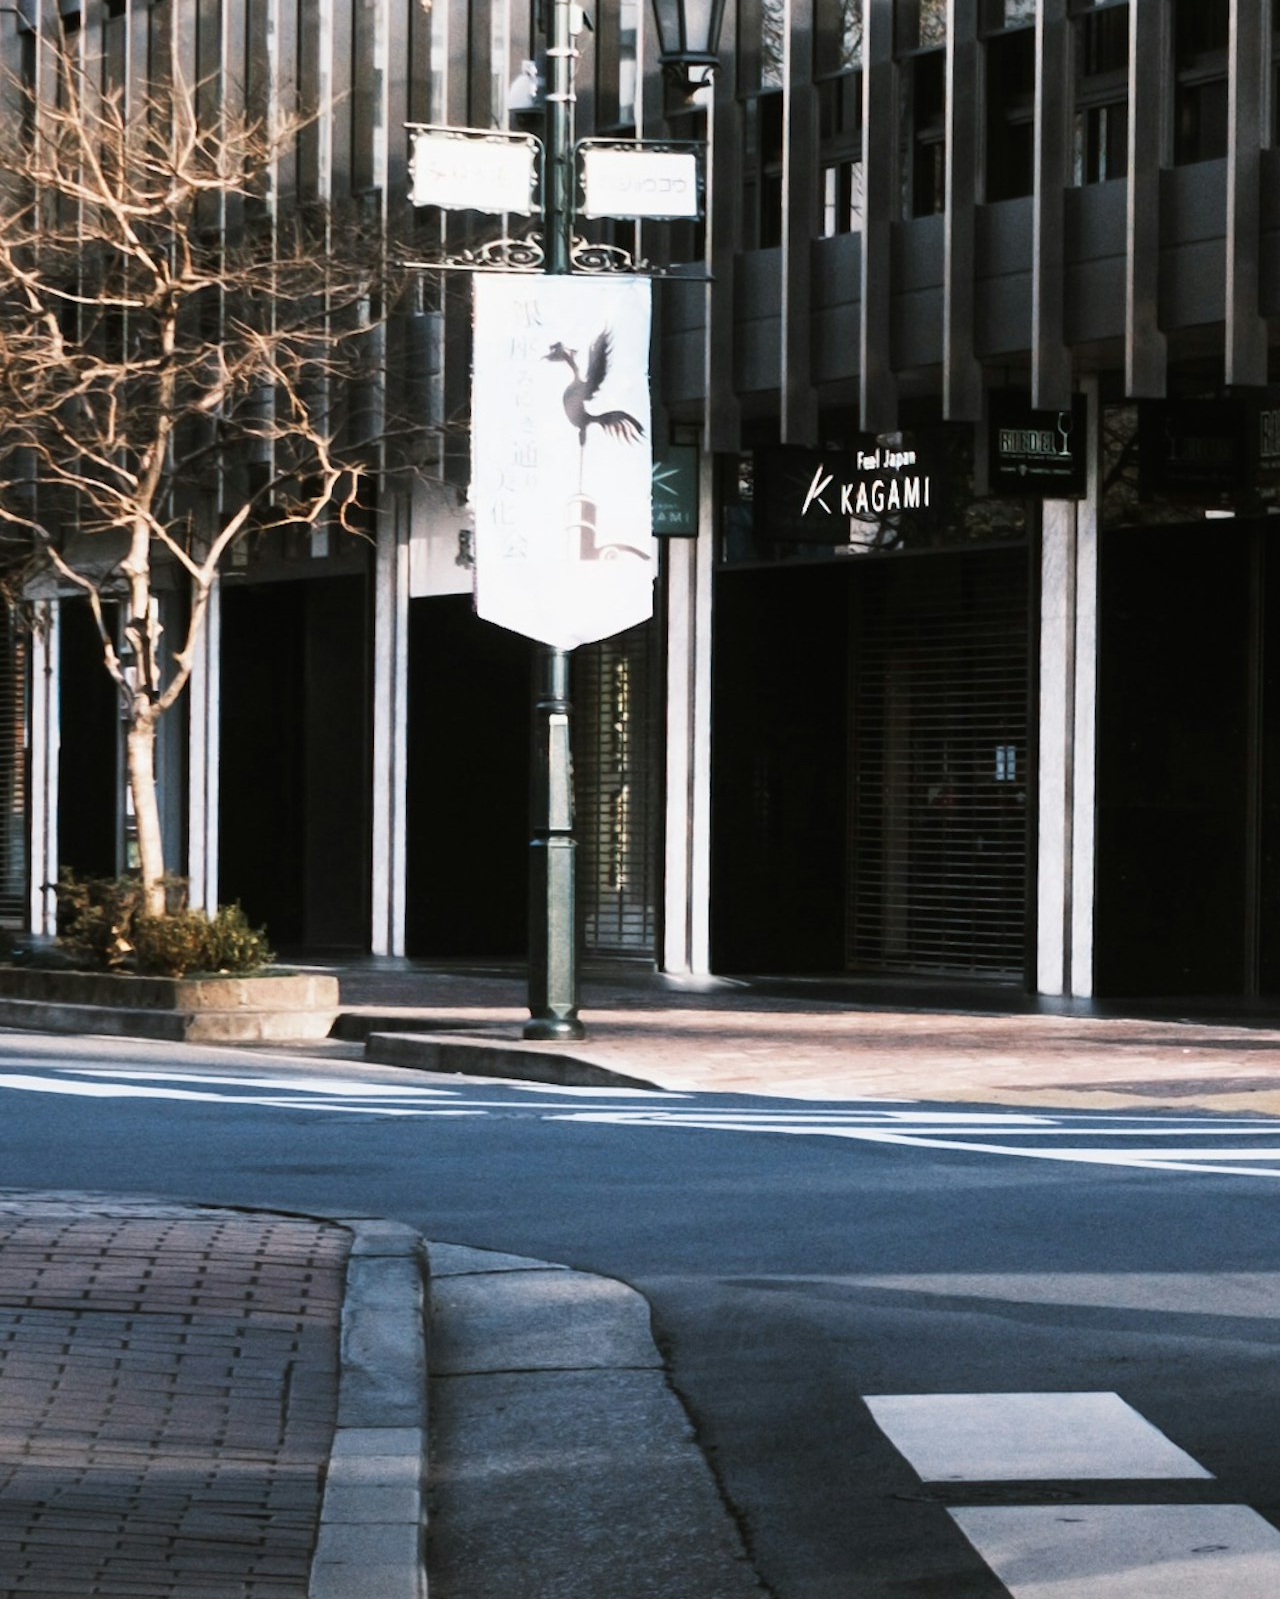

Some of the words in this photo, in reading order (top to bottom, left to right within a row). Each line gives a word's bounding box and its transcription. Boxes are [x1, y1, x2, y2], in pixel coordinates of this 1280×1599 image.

[856, 448, 881, 470] Feel
[883, 448, 917, 471] Japan
[841, 476, 931, 515] KAGAMI
